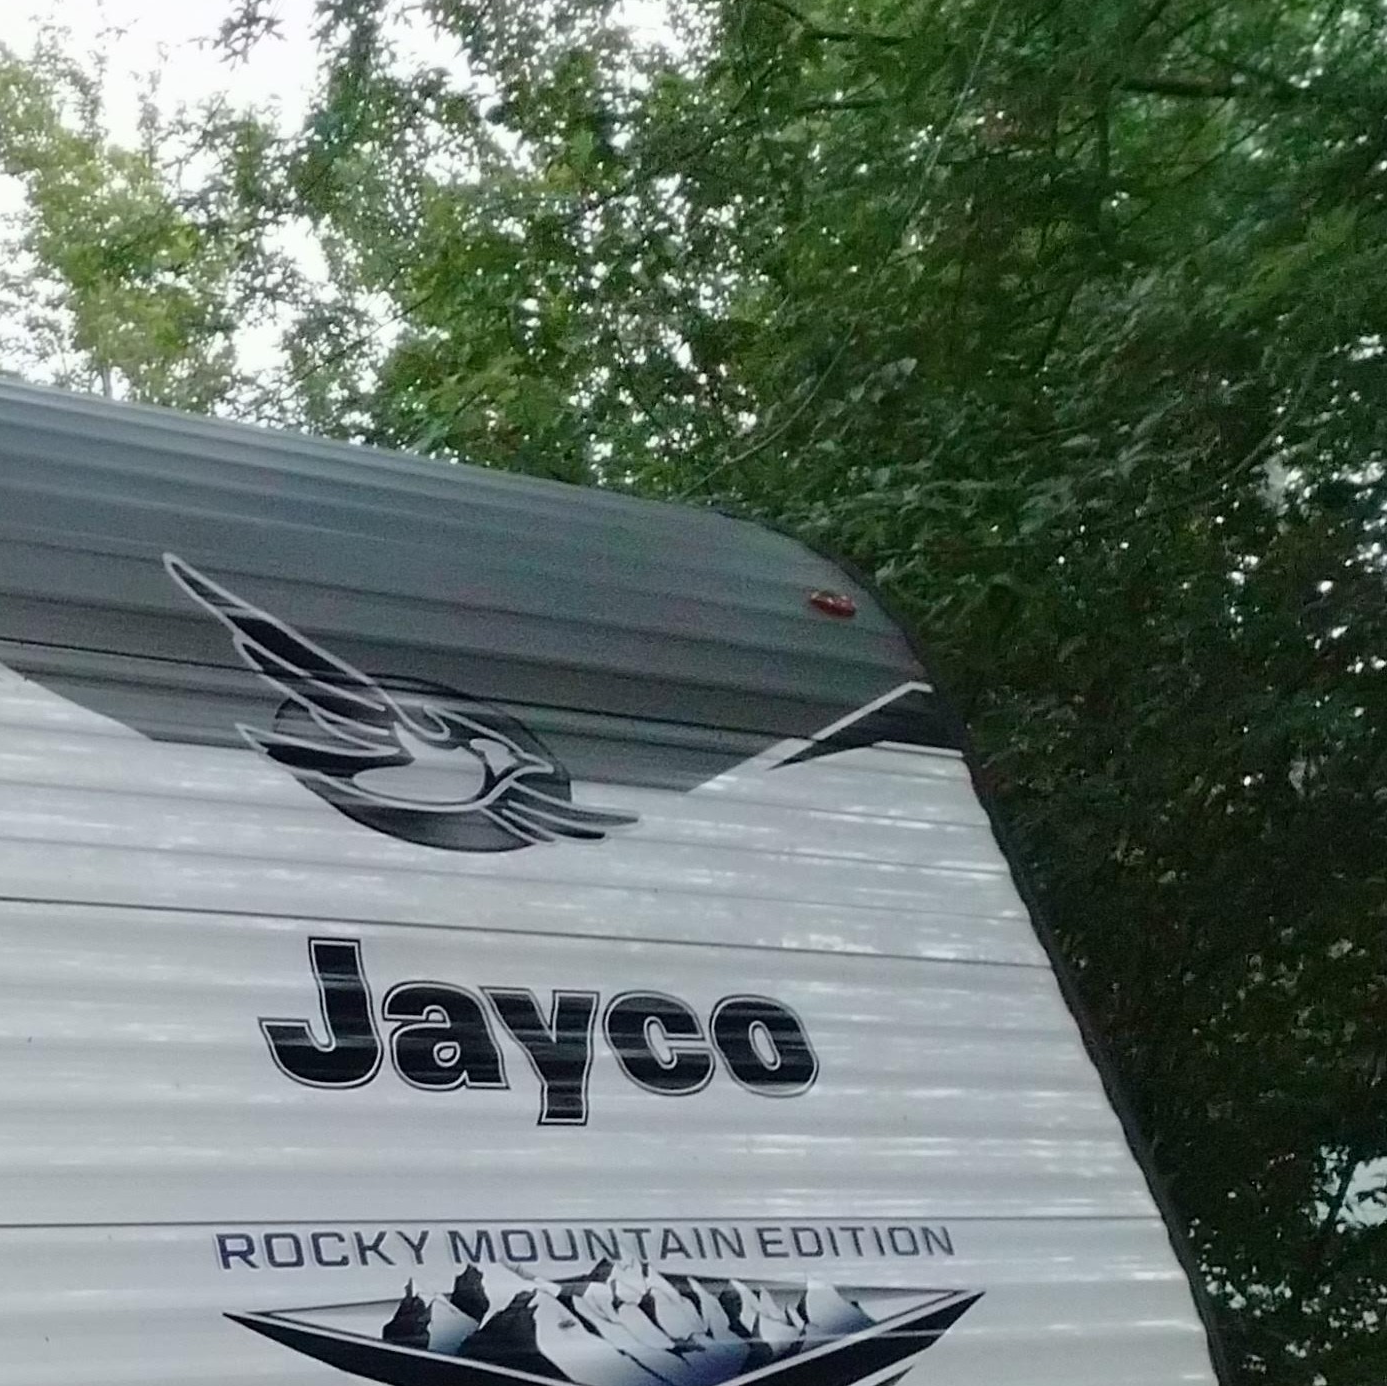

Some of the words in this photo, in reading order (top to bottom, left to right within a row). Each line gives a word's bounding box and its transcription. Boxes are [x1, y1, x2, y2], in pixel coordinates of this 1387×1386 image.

[258, 937, 819, 1127] Jayco
[214, 1229, 430, 1270] ROCKY
[446, 1226, 747, 1264] MOUNTAIN
[756, 1225, 956, 1259] EDITION
